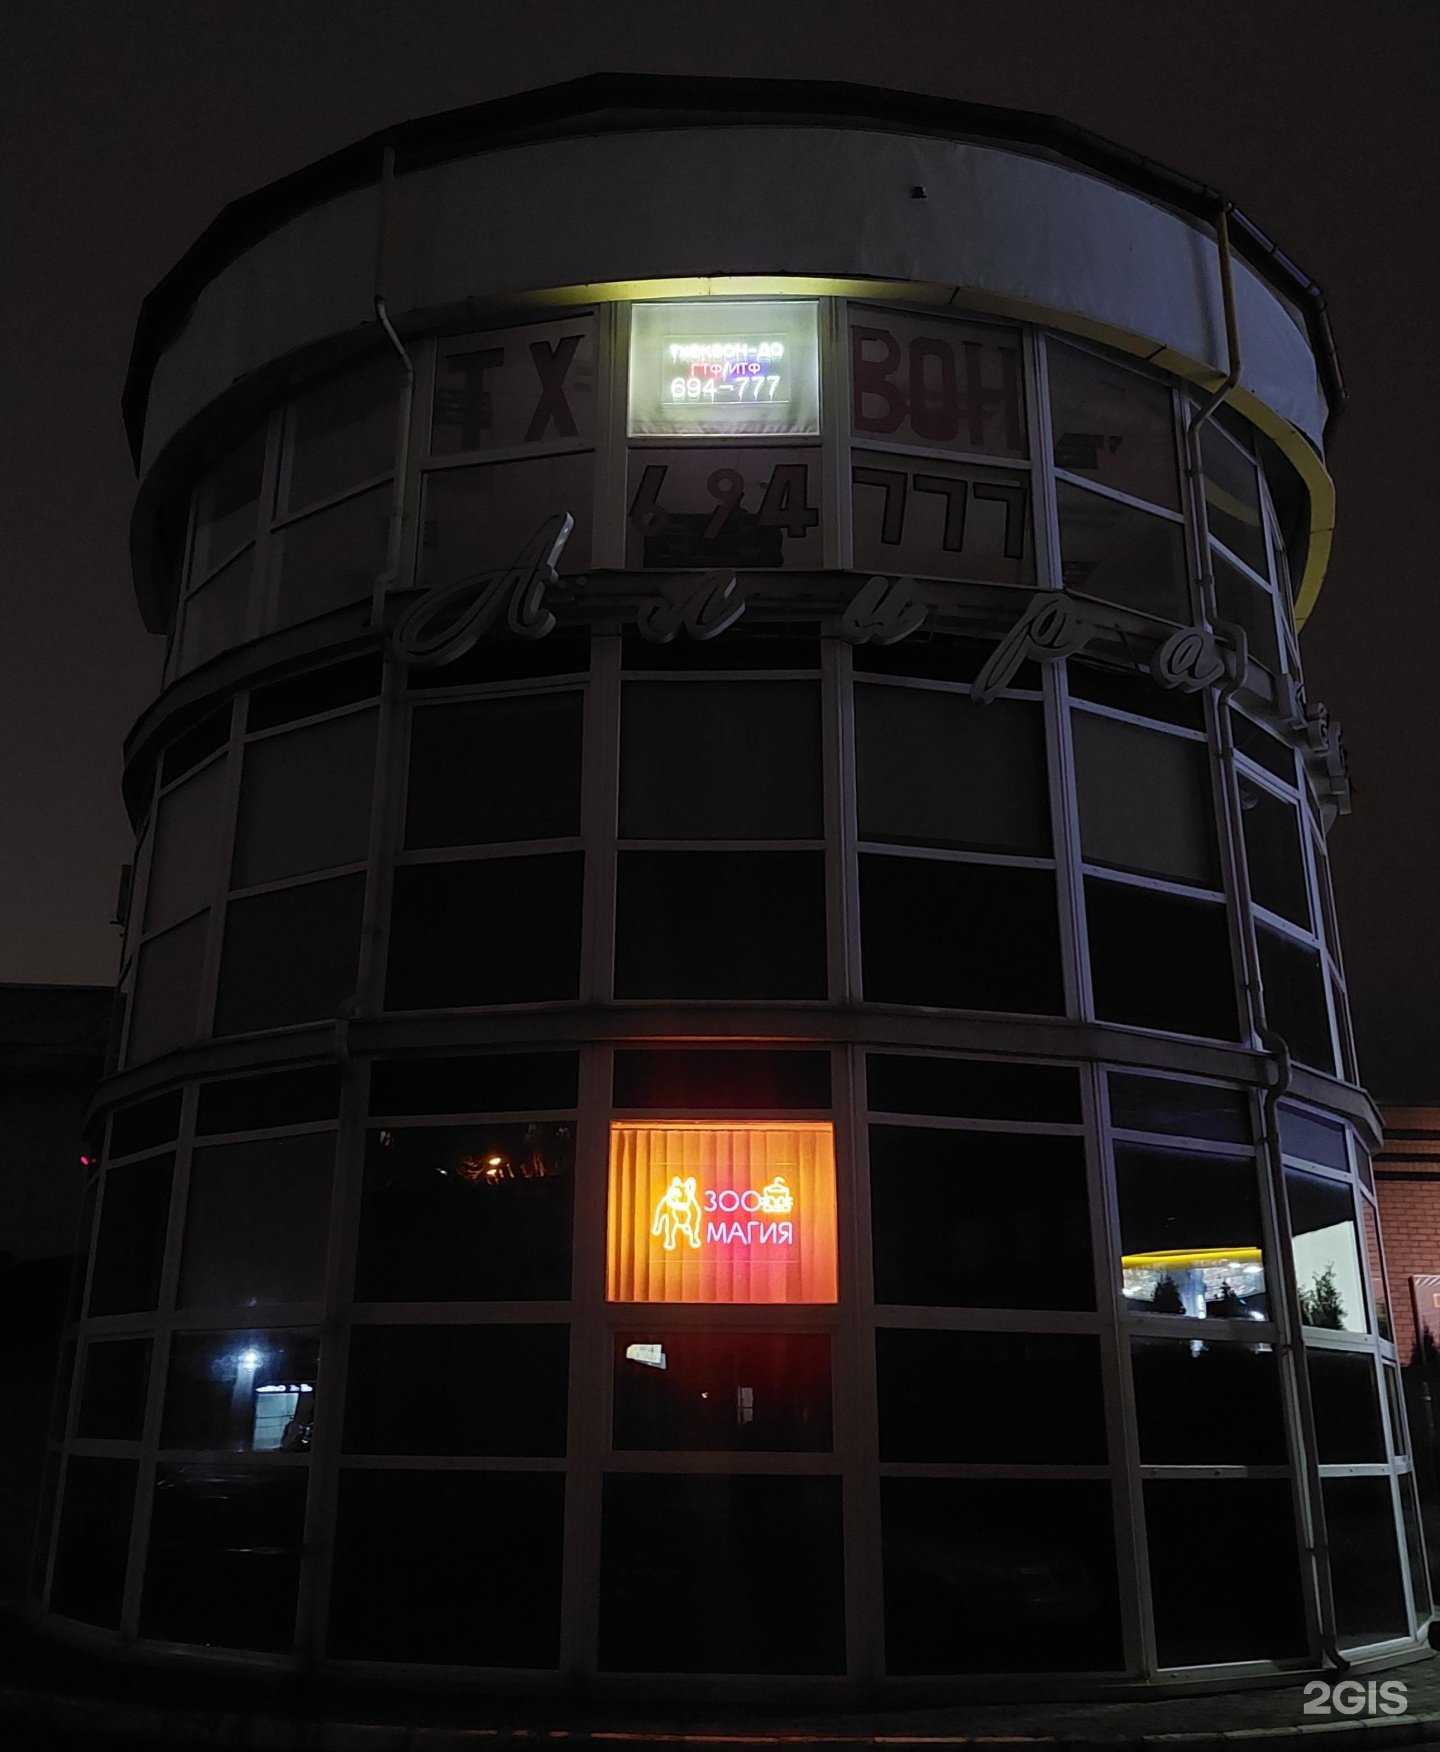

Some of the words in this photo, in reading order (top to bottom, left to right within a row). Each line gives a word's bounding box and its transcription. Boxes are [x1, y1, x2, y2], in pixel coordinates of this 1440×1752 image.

[671, 376, 781, 402] 694-777
[629, 463, 819, 540] 694
[851, 466, 1028, 560] 777
[703, 1189, 762, 1213] ЗОО
[706, 1221, 793, 1246] МАГИЯ
